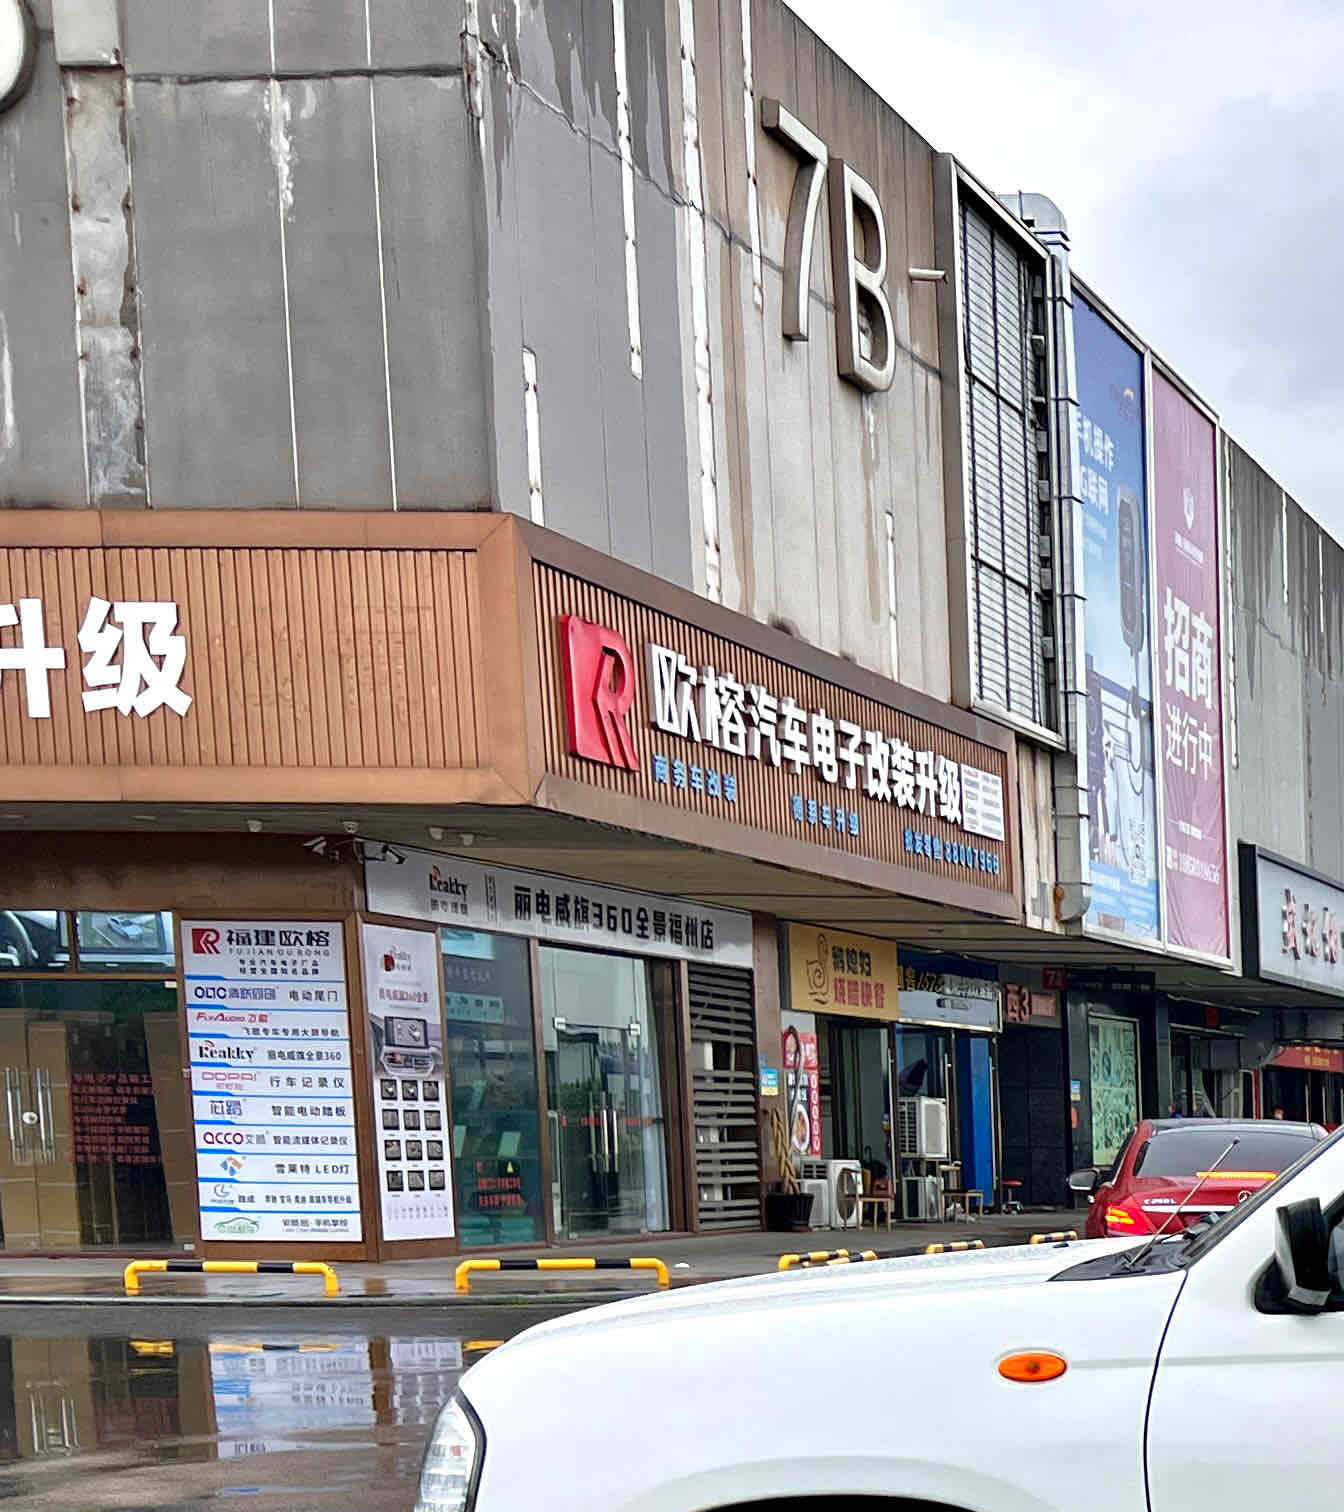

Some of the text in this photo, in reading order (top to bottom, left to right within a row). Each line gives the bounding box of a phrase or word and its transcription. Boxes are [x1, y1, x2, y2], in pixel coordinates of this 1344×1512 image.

[760, 96, 897, 394] 7B
[0, 596, 193, 720] 升级
[1164, 585, 1213, 710] 招商
[1165, 703, 1213, 780] 进行中
[513, 885, 714, 950] 丽电威旗360全景福州店
[270, 1077, 345, 1088] 行车记录仪
[271, 1105, 346, 1117] 智能电动踏板
